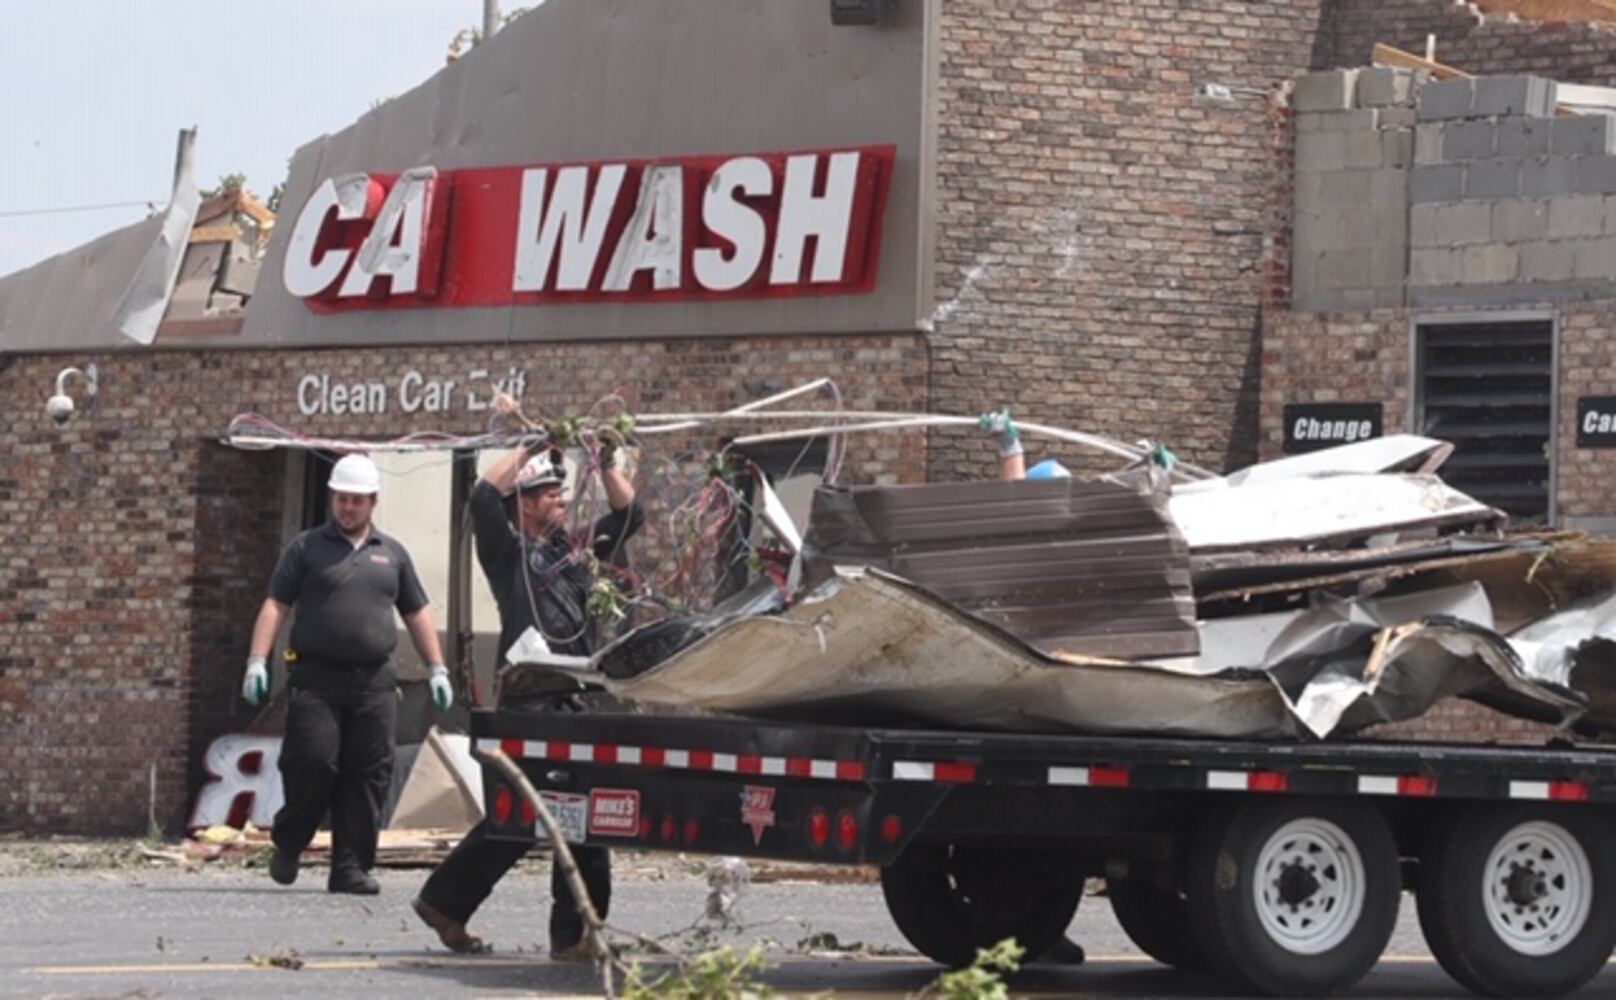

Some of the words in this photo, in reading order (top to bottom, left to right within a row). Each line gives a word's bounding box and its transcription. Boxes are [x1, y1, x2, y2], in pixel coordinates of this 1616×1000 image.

[512, 150, 861, 292] WASH
[298, 373, 387, 416] Clean
[400, 370, 454, 413] Car
[1293, 417, 1373, 441] Change
[594, 795, 635, 817] MIKE'S
